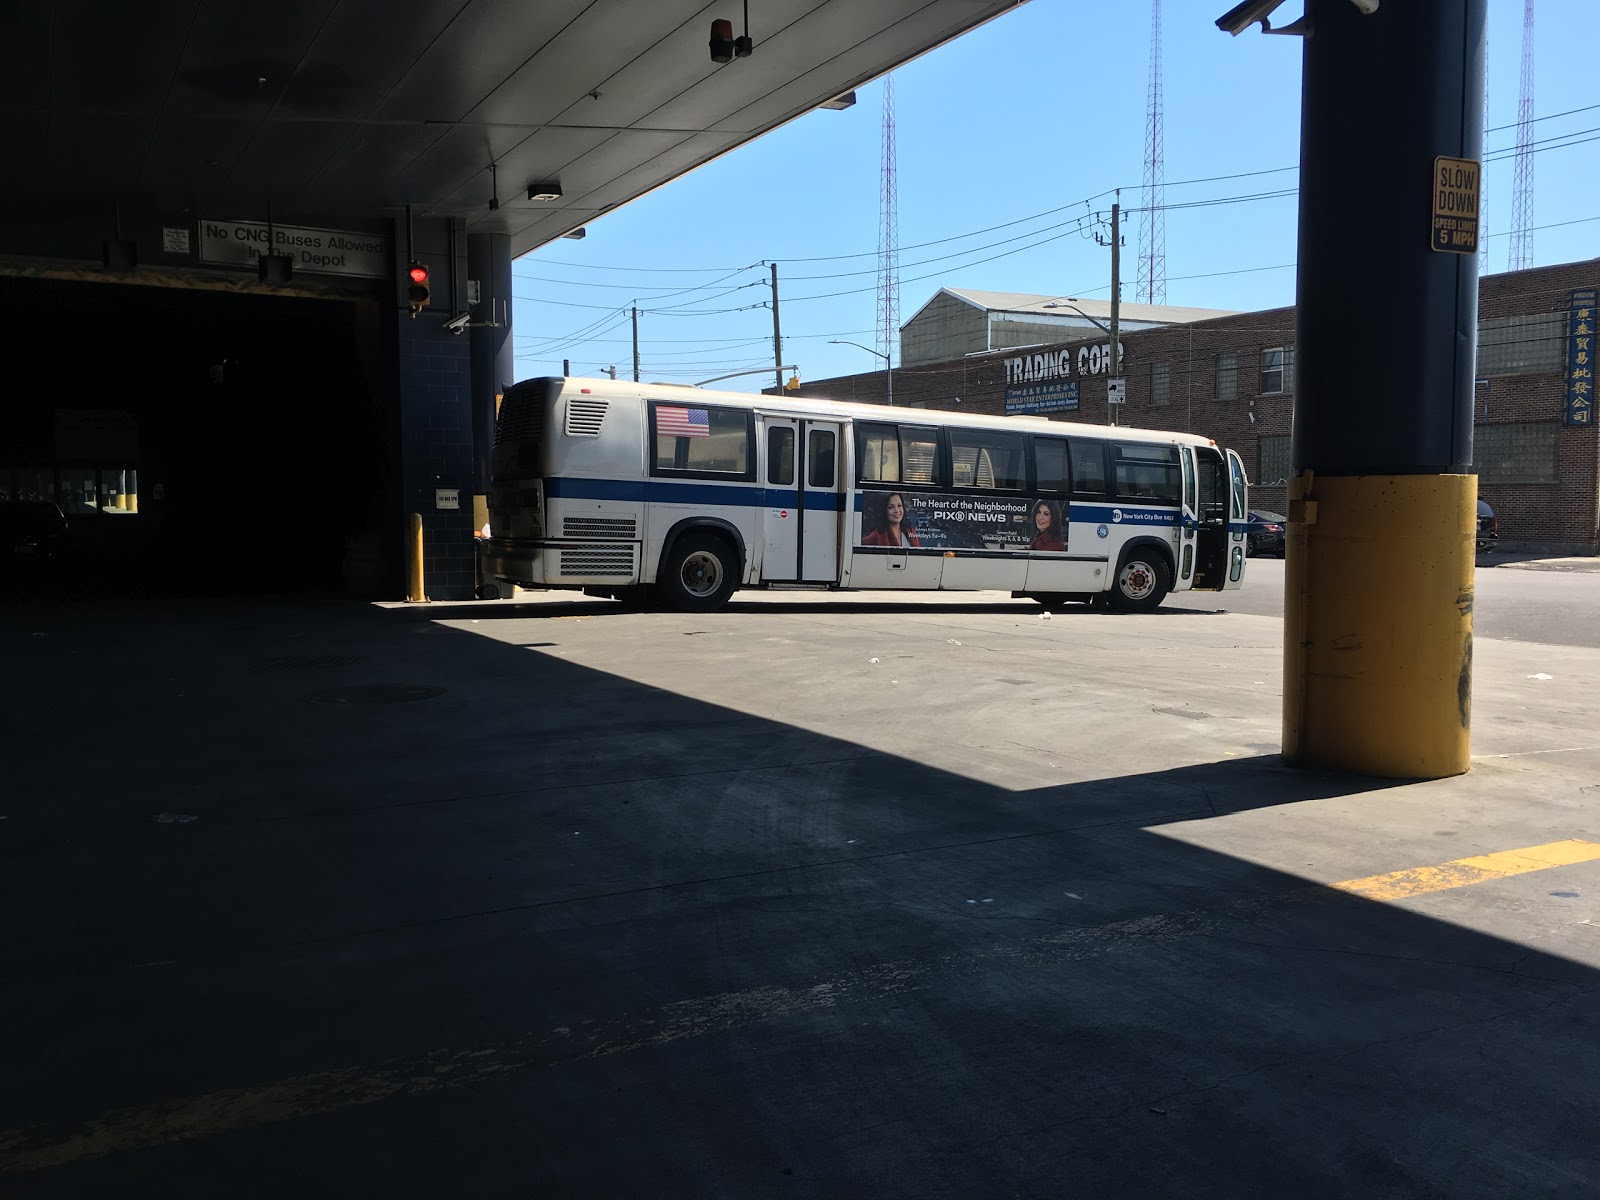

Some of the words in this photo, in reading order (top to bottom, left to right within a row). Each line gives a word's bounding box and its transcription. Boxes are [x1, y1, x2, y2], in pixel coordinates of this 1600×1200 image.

[1441, 167, 1475, 190] SLOW
[1438, 190, 1475, 213] DOWN
[1435, 218, 1457, 230] SPEED
[1457, 220, 1476, 232] LIMIT
[206, 224, 228, 239] No
[234, 227, 269, 243] CNG
[275, 231, 322, 248] Buses
[327, 236, 384, 254] Allowed
[1440, 230, 1449, 244] 5
[1452, 231, 1475, 247] MPH
[248, 246, 261, 259] In
[301, 251, 346, 267] Depot
[1004, 349, 1070, 385] TRADING
[1035, 391, 1068, 402] ENTERPRISES
[912, 498, 927, 508] The
[928, 499, 950, 509] Heart
[950, 500, 960, 509] of
[960, 500, 973, 510] the
[974, 502, 1027, 513] Neighborhood
[967, 512, 1007, 523] NEWS
